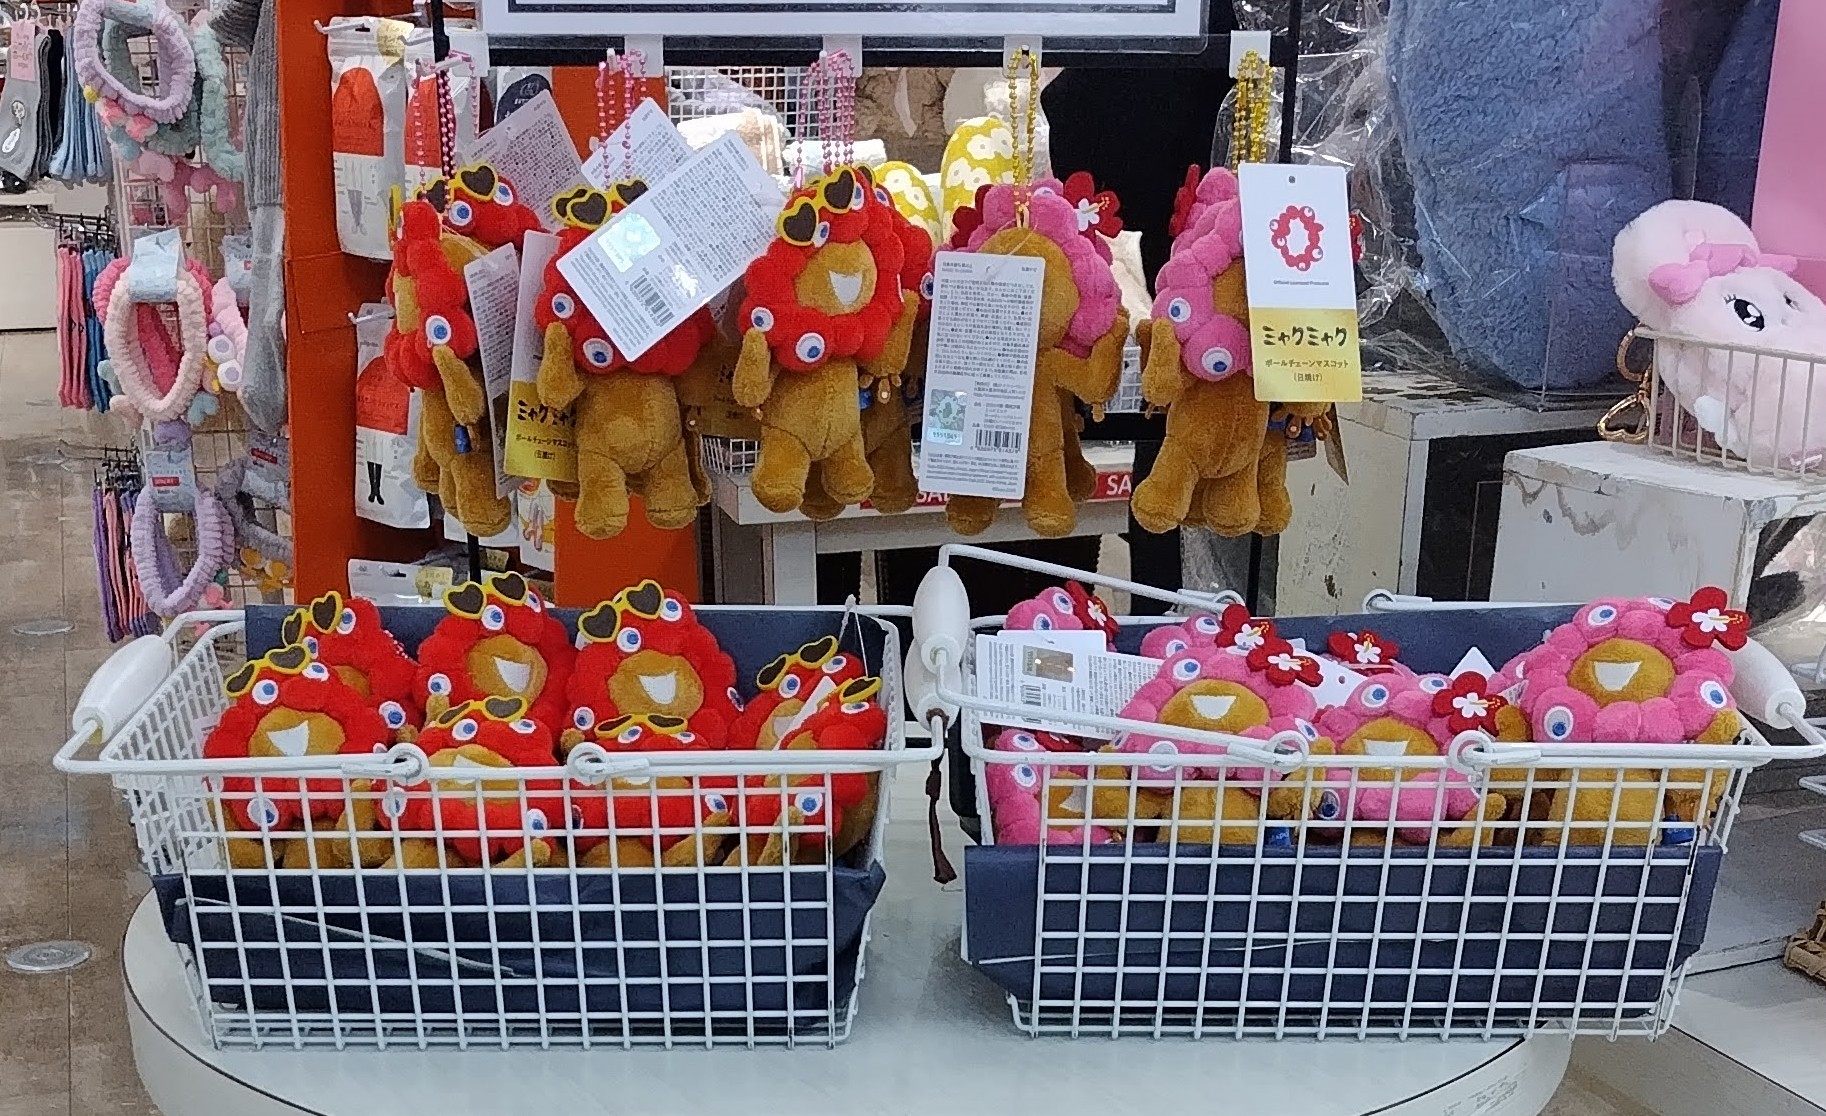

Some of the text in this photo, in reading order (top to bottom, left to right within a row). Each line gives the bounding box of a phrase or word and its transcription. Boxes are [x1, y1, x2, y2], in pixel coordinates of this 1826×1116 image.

[1262, 325, 1347, 346] ミャクミャク
[1265, 359, 1349, 368] ボールチェーンマスコット
